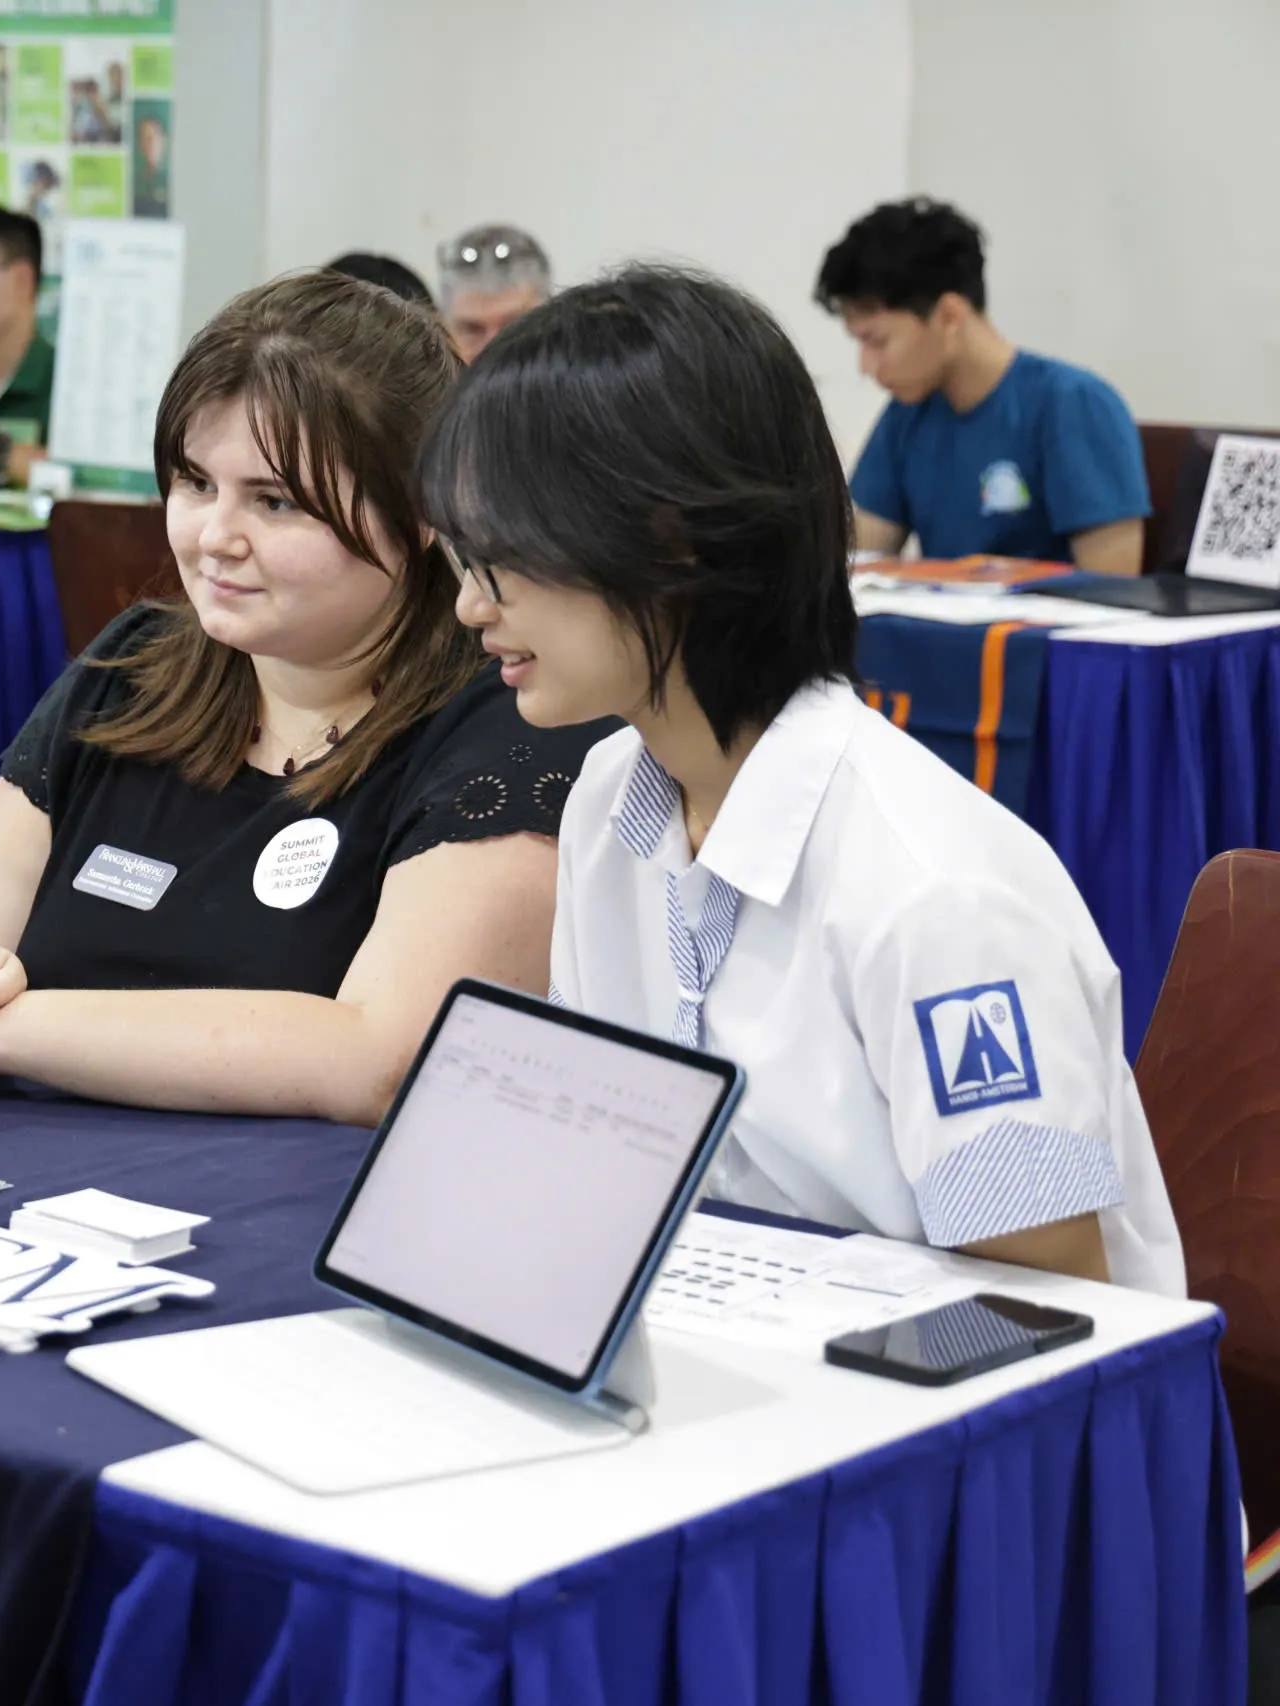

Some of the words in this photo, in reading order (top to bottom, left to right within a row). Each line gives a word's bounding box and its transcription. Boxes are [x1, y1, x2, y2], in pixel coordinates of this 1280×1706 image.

[280, 834, 325, 851] SUMMIT
[277, 849, 322, 864] GLOBAL
[264, 859, 328, 878] DUCATION
[294, 874, 321, 888] 2026
